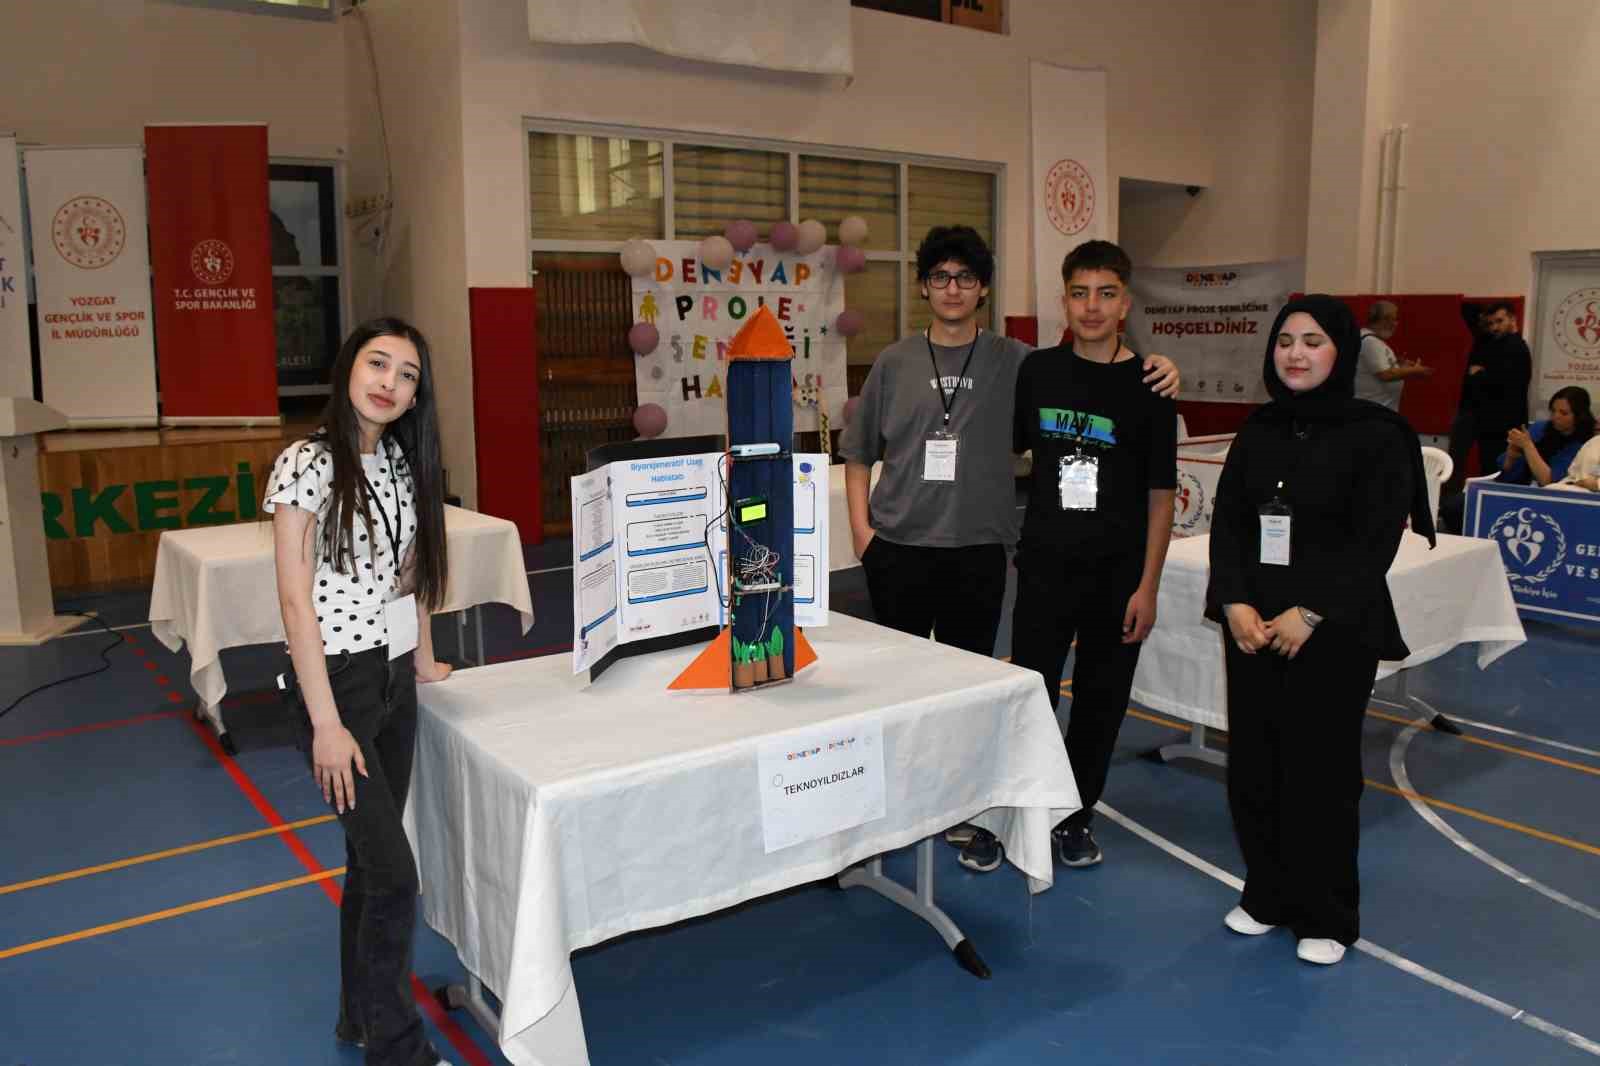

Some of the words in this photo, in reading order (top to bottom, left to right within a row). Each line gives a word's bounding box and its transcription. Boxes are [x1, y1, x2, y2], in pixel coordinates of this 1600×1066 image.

[241, 288, 256, 298] VE
[70, 296, 116, 306] YOZGAT
[176, 301, 201, 310] SPOR
[675, 296, 792, 321] PROE
[45, 312, 94, 324] GENÇLİK
[97, 312, 112, 321] VE
[115, 311, 145, 321] SPOR
[1152, 316, 1258, 339] HOŞGELDİNİZ
[1565, 565, 1585, 577] VE
[784, 766, 864, 795] TEKNOYILDIZLAR
